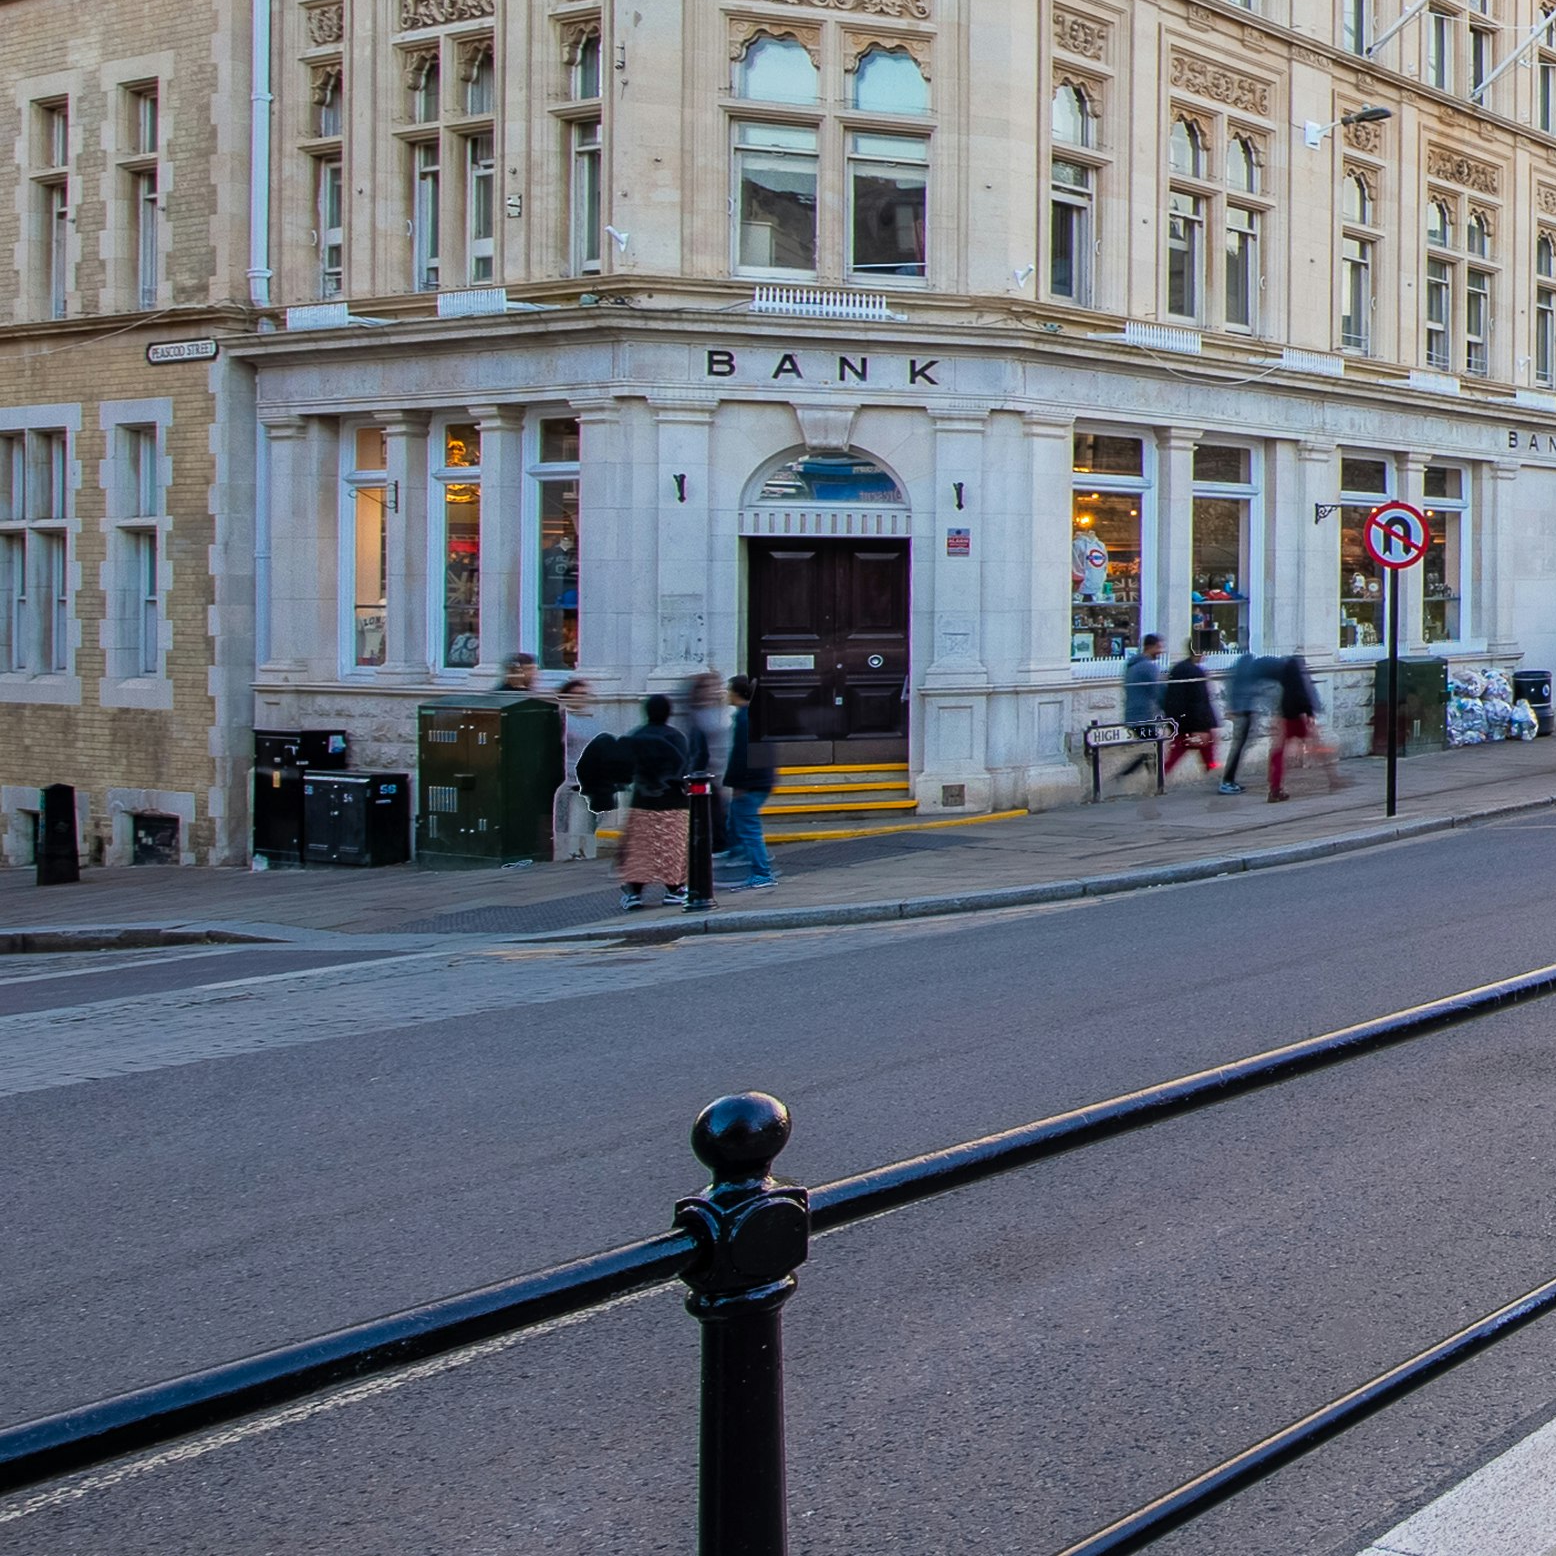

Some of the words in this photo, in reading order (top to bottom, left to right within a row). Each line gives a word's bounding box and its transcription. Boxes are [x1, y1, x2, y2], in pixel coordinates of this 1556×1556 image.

[151, 345, 186, 359] PEASCOD
[187, 342, 214, 356] STREET
[706, 350, 940, 386] BANK
[1094, 730, 1120, 743] HIGH
[1126, 724, 1168, 740] SRE
